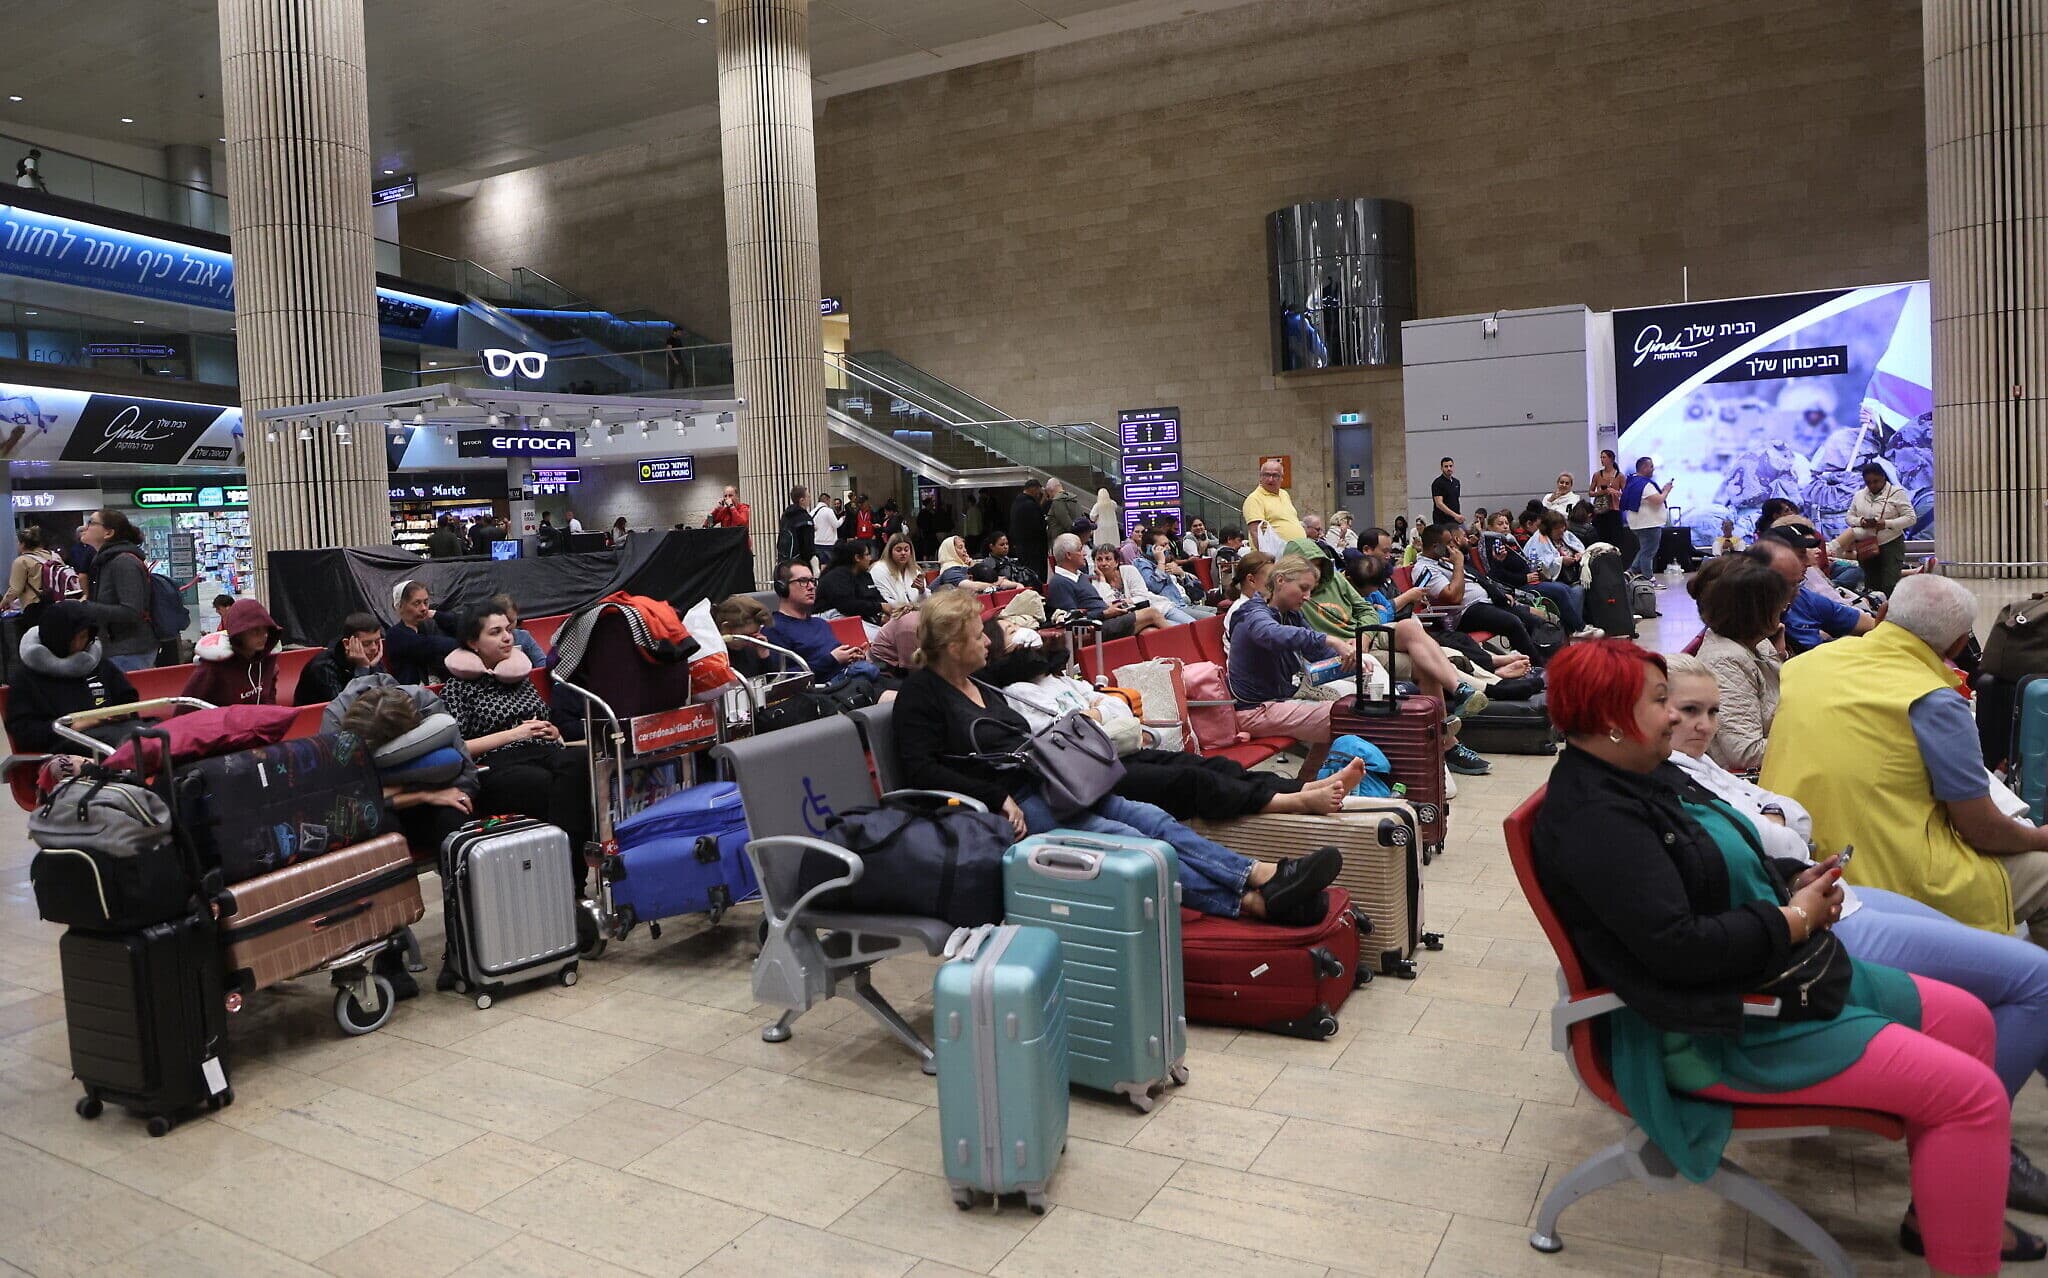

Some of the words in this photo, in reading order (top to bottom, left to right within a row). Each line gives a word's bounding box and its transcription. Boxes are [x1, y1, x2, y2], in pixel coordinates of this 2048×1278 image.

[5, 220, 76, 259] לחזור
[83, 237, 131, 269] יותר
[136, 249, 173, 283] כיף
[178, 253, 222, 287] אבל
[1684, 323, 1715, 342] שלך
[1719, 321, 1756, 336] הבית
[1745, 357, 1777, 376] שלך
[1782, 354, 1839, 374] הביטחון
[651, 470, 665, 478] LOST
[671, 469, 690, 477] FOUND
[432, 484, 466, 497] Market
